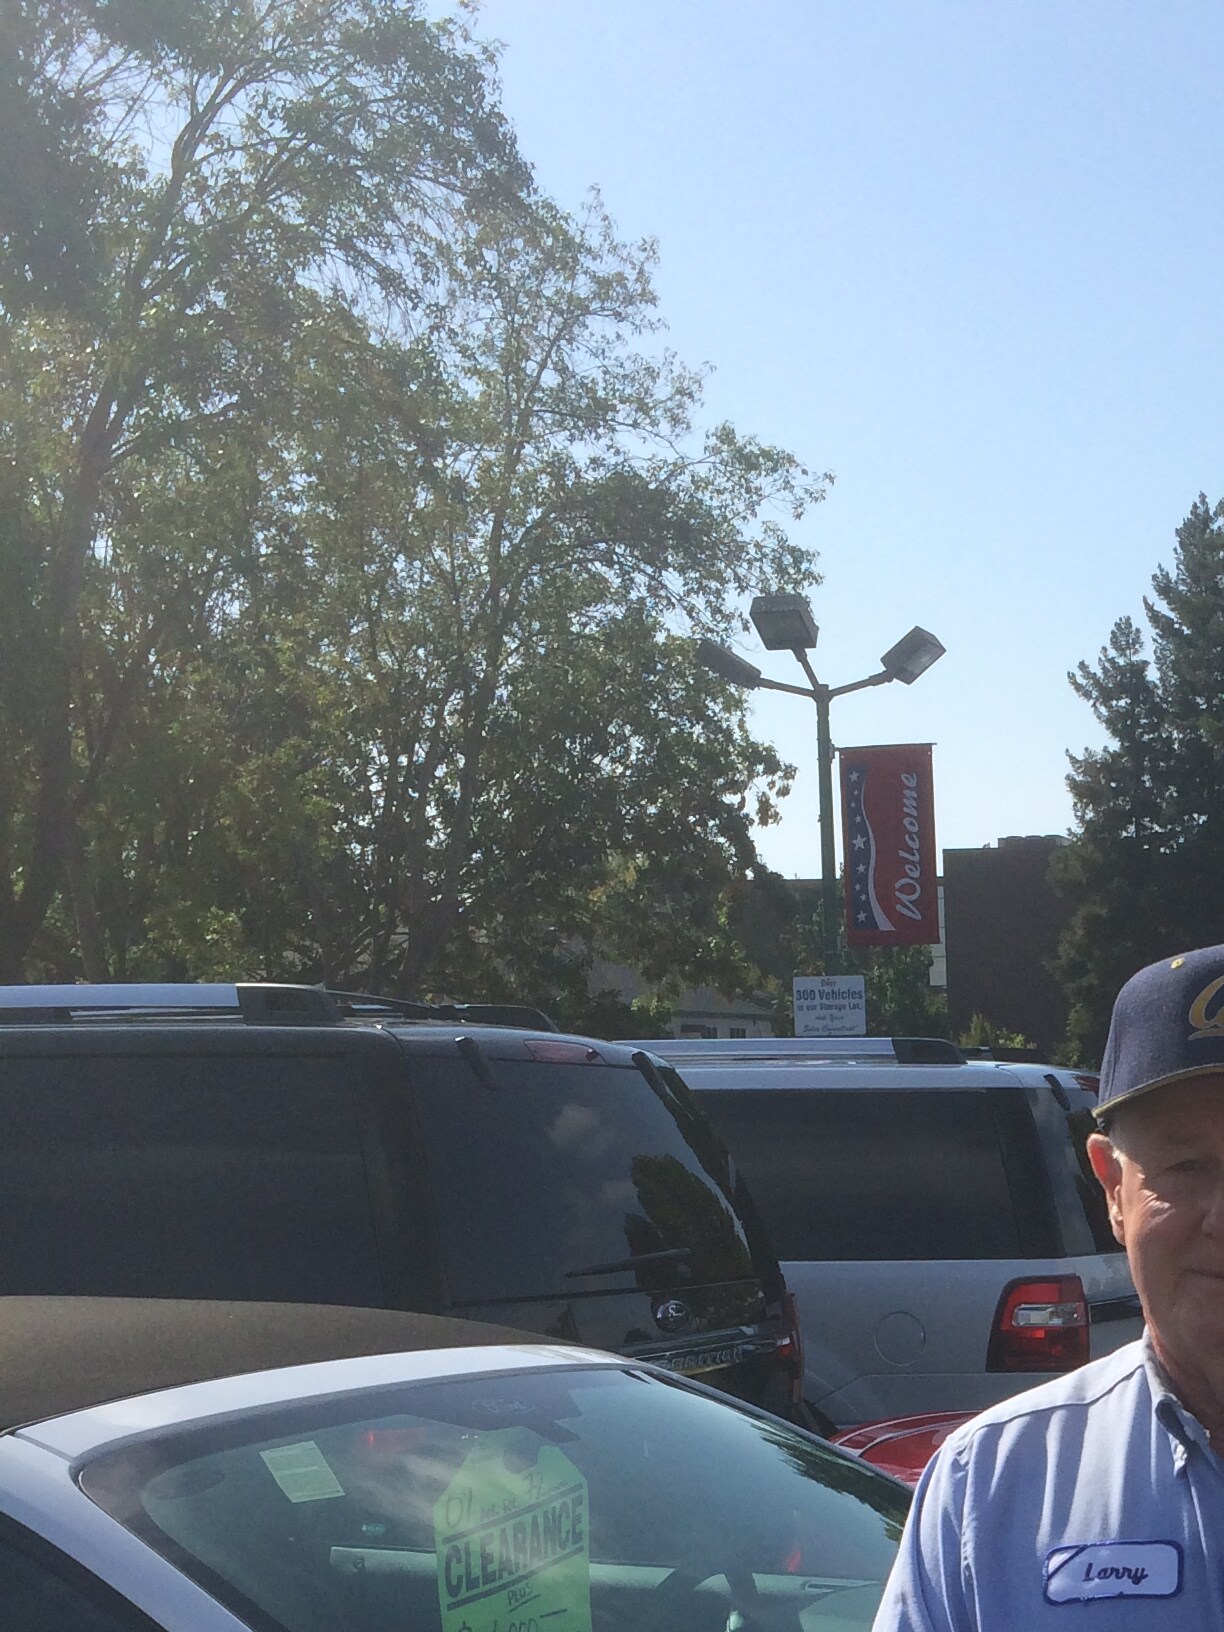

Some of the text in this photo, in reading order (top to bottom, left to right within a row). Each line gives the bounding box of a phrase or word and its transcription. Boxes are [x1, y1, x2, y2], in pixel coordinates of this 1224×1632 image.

[894, 772, 922, 921] Welcome
[796, 988, 864, 1001] 300 Vehicles
[820, 978, 837, 989] Over
[444, 1494, 584, 1599] CLEARANCE
[1082, 1563, 1149, 1585] Larry
